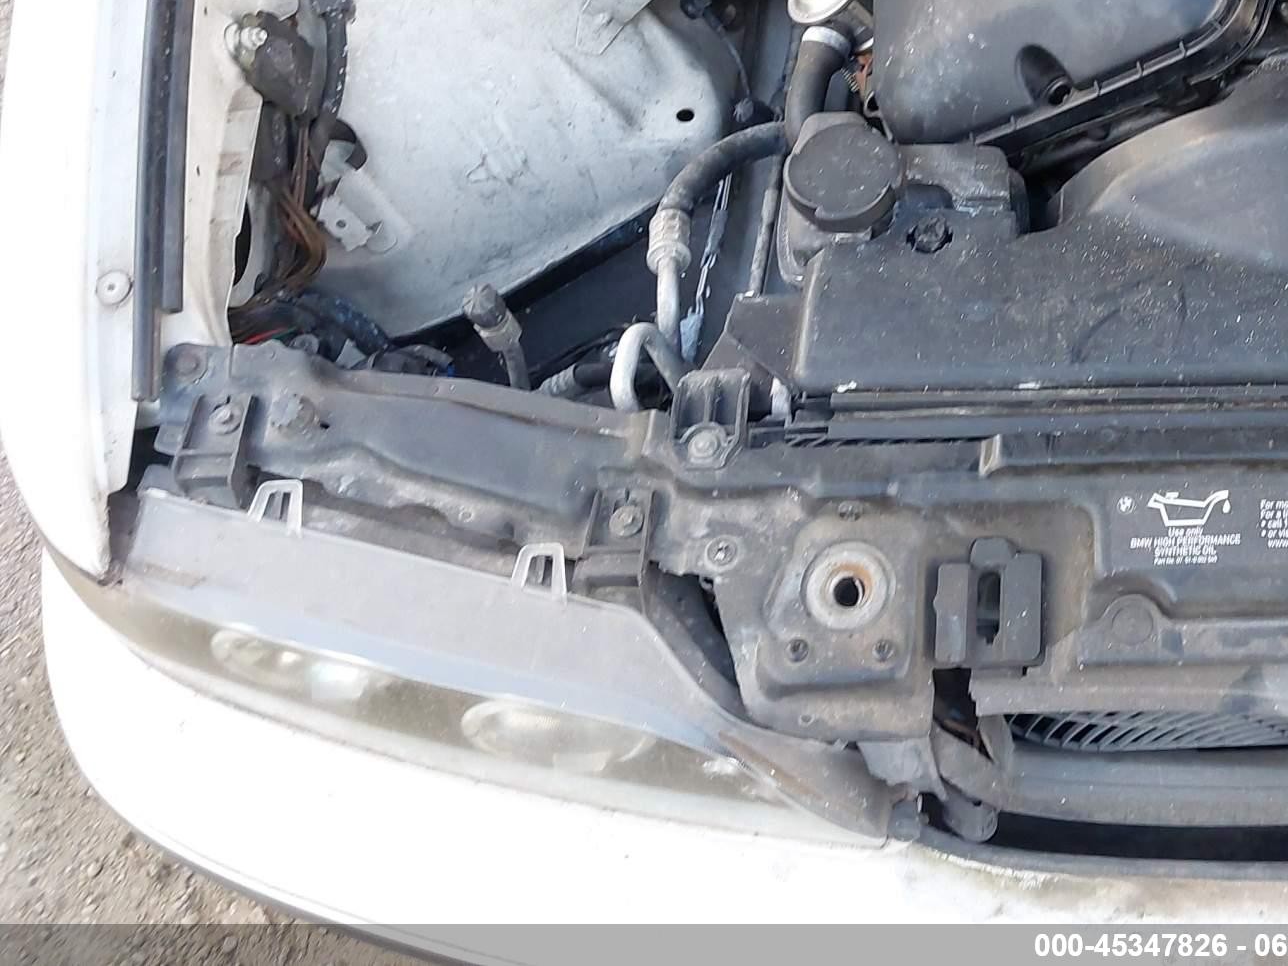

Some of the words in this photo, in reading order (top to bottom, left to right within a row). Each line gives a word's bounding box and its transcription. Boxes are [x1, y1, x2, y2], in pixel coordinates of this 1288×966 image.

[1260, 499, 1275, 509] For
[1260, 509, 1275, 519] For
[1267, 519, 1282, 529] call
[1168, 527, 1185, 537] Use
[1185, 526, 1204, 538] only
[1267, 530, 1276, 538] or
[1130, 537, 1152, 549] BMW
[1154, 536, 1175, 548] HIGH
[1176, 533, 1241, 547] PERFORMANCE
[1154, 545, 1201, 557] SYNTHETIC
[1202, 544, 1217, 555] OIL
